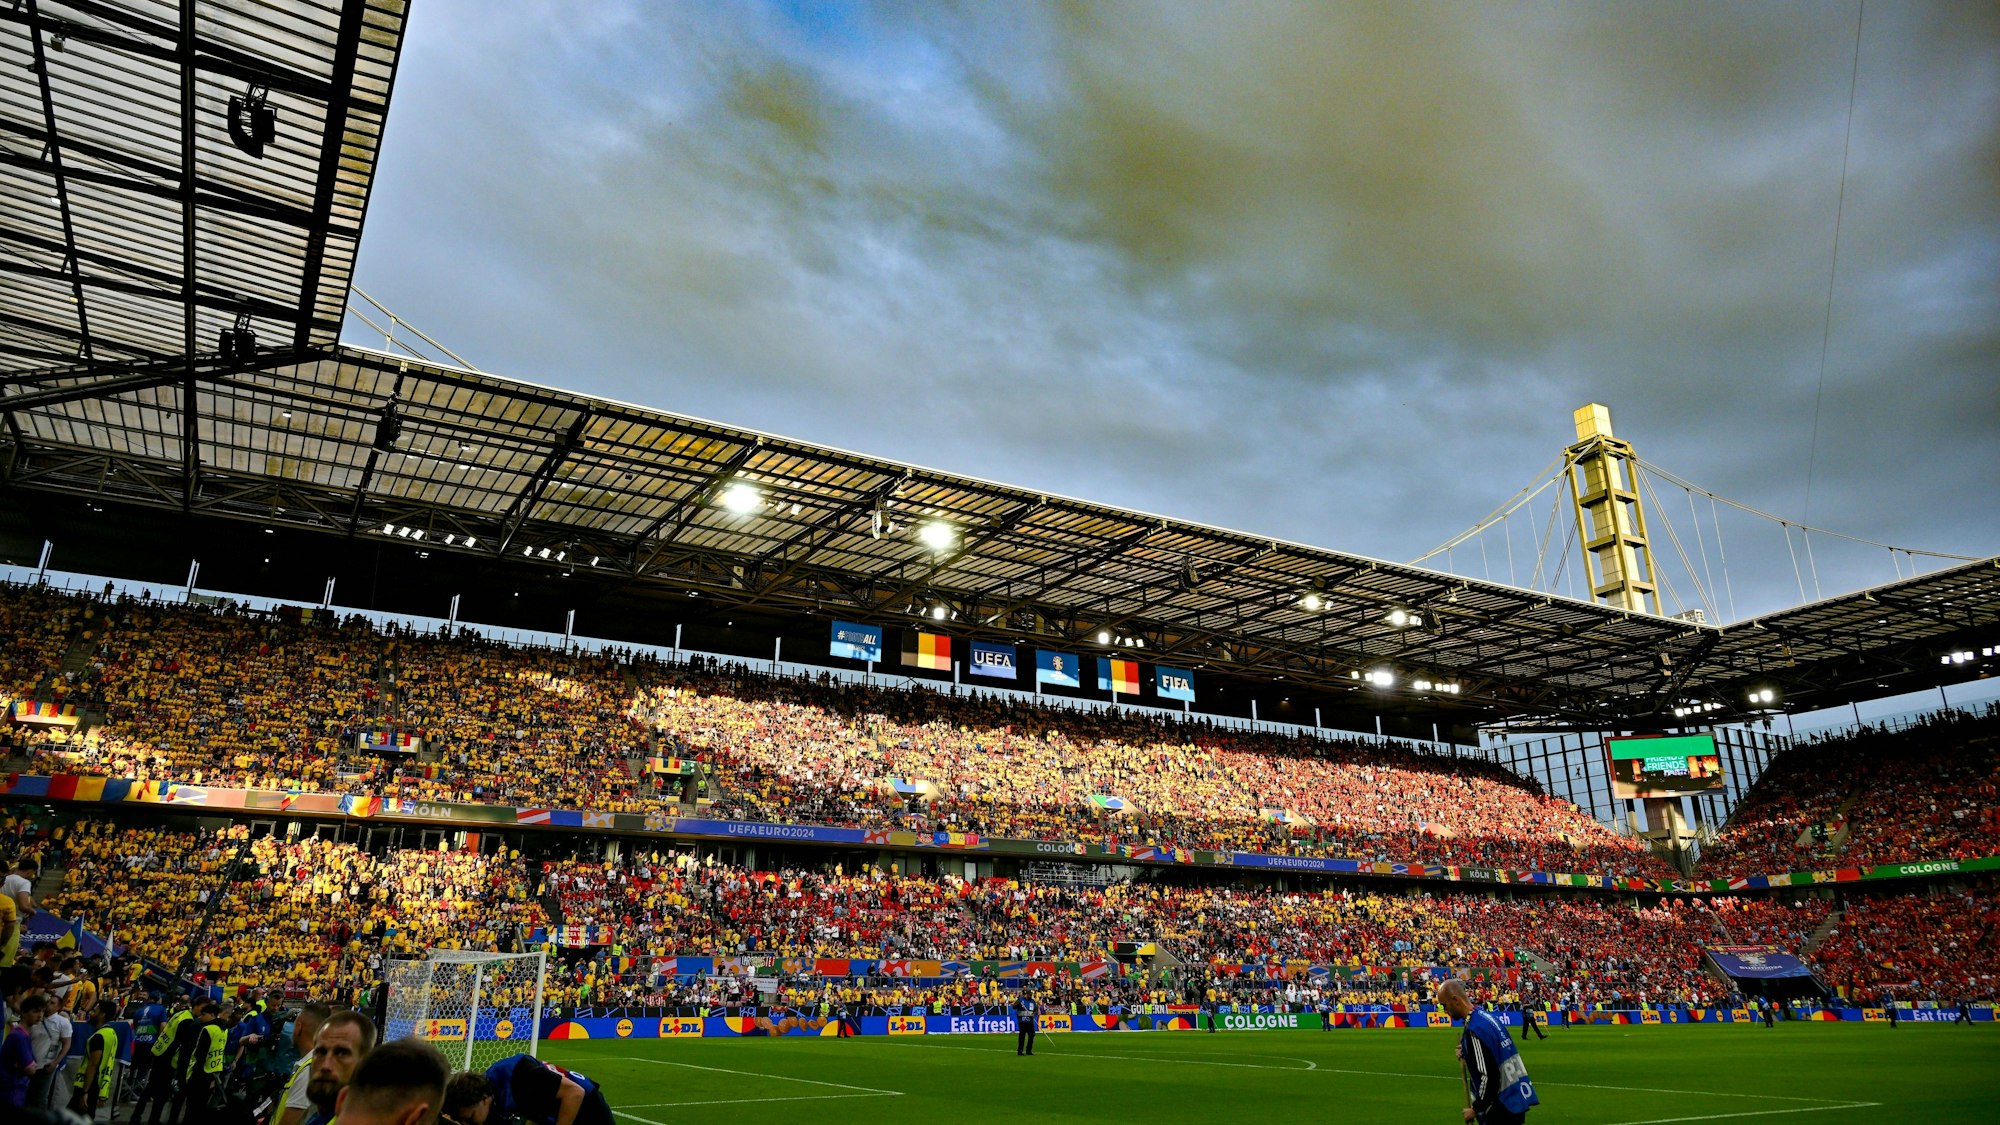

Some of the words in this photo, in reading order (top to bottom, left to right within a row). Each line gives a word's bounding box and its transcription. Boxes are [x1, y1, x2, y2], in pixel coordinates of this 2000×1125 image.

[974, 651, 1012, 669] UEFA
[1162, 675, 1190, 692] FIFA
[1646, 760, 1687, 771] FRIENDS
[1469, 869, 1491, 879] KÖLN
[1900, 862, 1960, 874] COLOGNE
[1224, 1014, 1297, 1028] COLOGNE
[1912, 1009, 1935, 1021] Eat
[950, 1017, 975, 1032] Eat
[977, 1016, 1016, 1032] fresh
